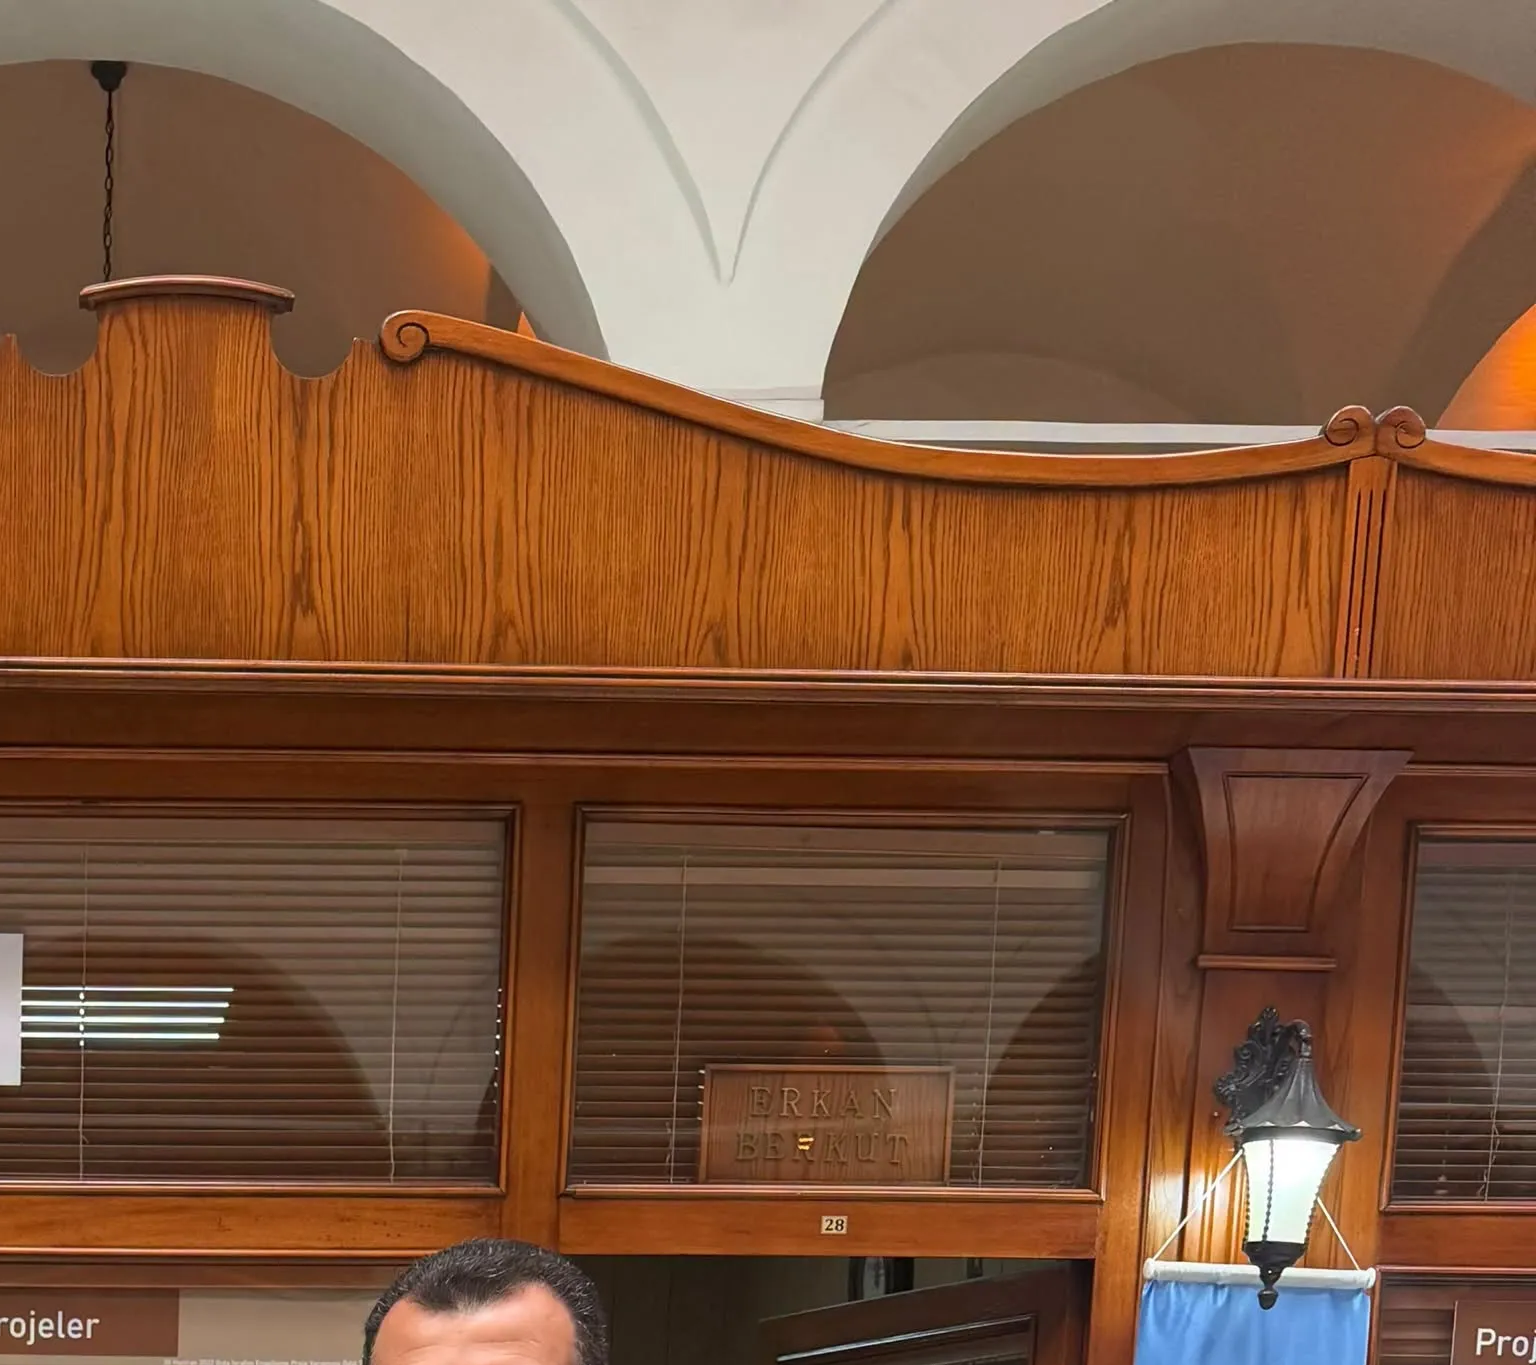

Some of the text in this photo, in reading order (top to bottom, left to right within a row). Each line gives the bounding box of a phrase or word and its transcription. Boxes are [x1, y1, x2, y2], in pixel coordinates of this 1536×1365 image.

[750, 1086, 898, 1120] ERKAN
[735, 1132, 910, 1166] BERKUT
[824, 1218, 845, 1232] 28
